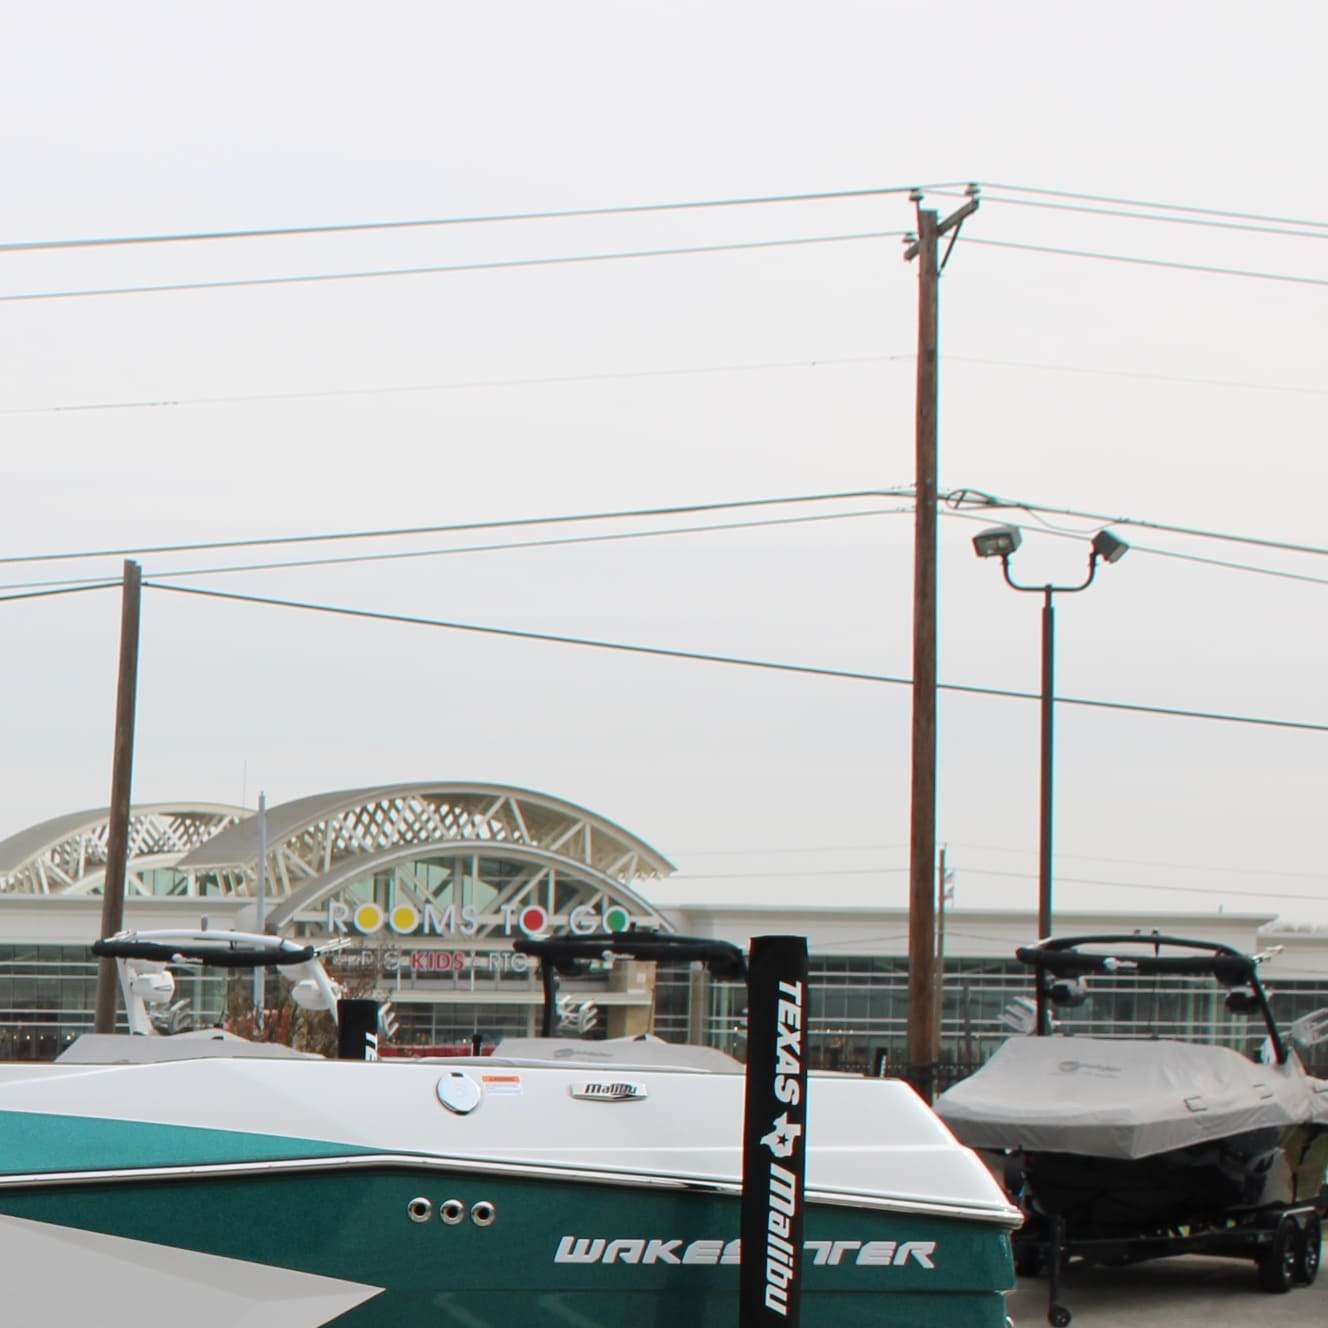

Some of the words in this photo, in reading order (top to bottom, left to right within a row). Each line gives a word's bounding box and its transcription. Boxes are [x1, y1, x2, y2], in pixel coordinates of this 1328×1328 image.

[327, 902, 479, 936] ROOMS
[499, 903, 549, 940] TO
[568, 904, 631, 936] GO
[409, 951, 465, 972] KIDS
[774, 979, 803, 1107] TEXAS
[553, 1235, 937, 1269] WAKETTER
[764, 1162, 797, 1317] Malibu
